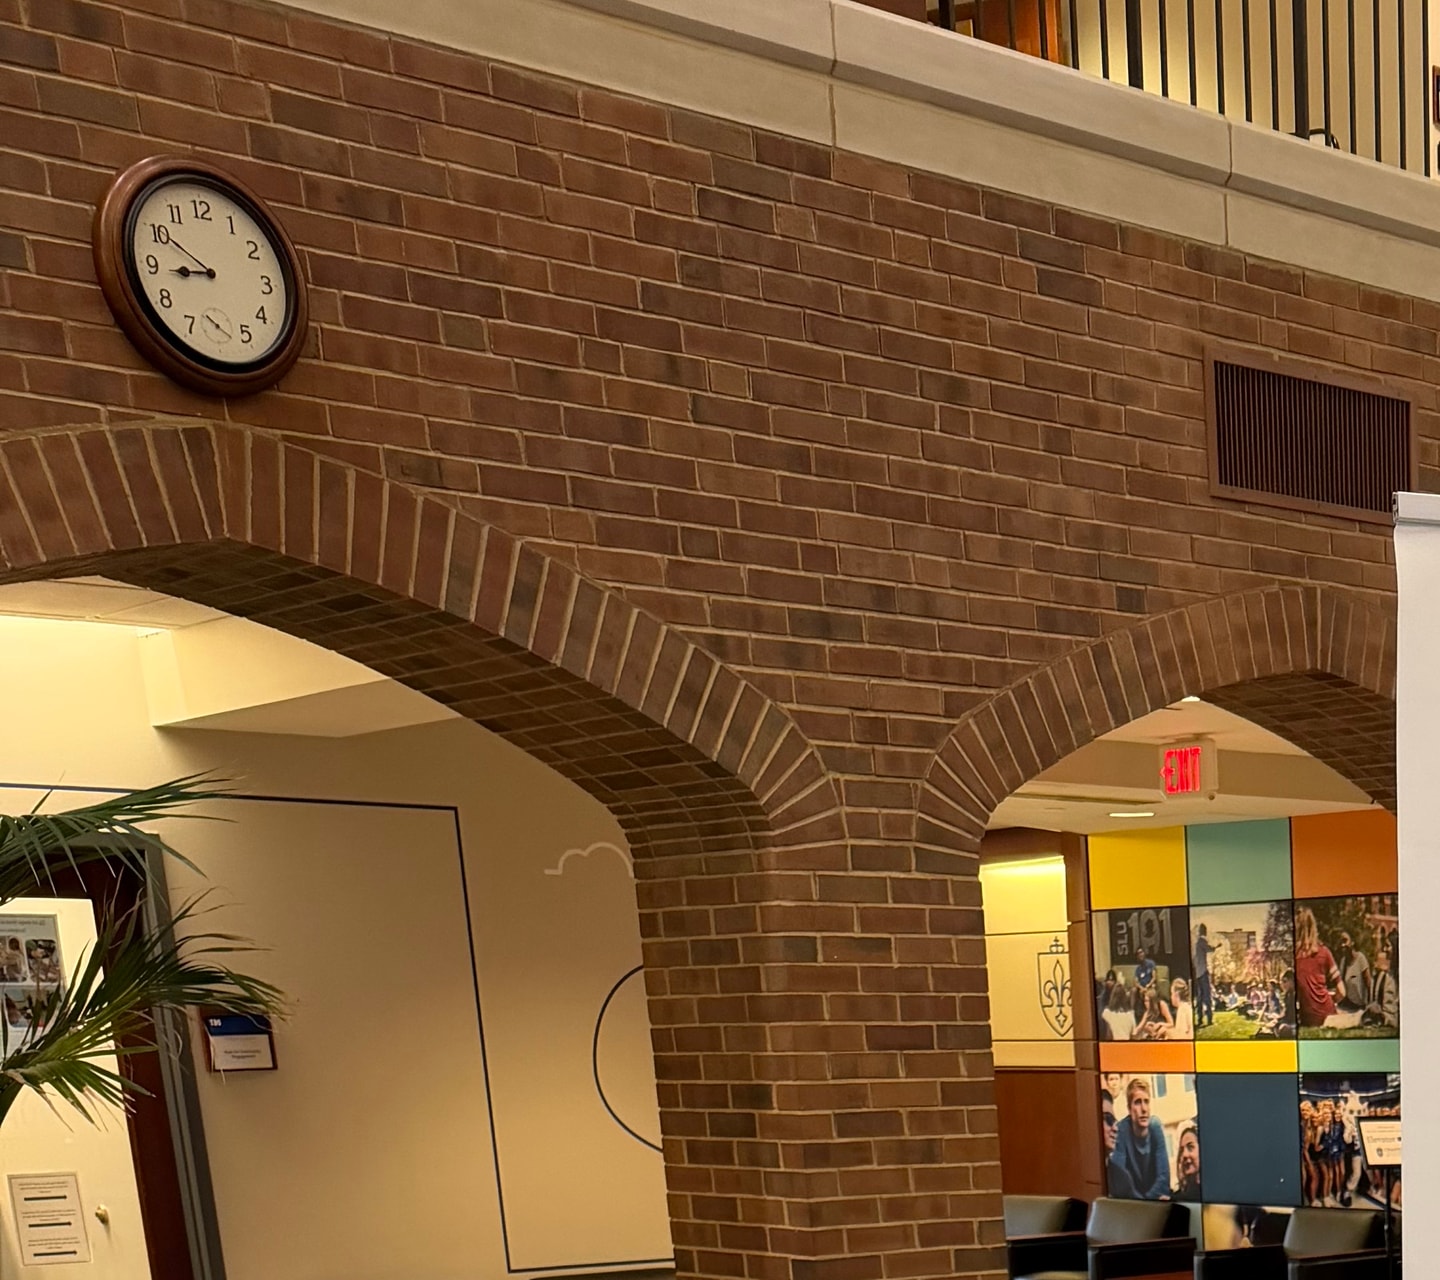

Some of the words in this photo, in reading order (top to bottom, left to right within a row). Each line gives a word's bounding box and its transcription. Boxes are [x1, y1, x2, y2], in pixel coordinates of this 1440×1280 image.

[167, 204, 183, 225] 11
[191, 200, 212, 221] 12
[150, 224, 170, 244] 10
[226, 216, 236, 235] 1
[246, 241, 260, 260] 2
[146, 255, 159, 274] 9
[260, 276, 273, 295] 3
[159, 289, 172, 309] 8
[184, 315, 196, 334] 7
[255, 305, 267, 325] 4
[240, 324, 252, 343] 5
[1164, 747, 1201, 794] EXIT
[1117, 921, 1128, 955] SLU
